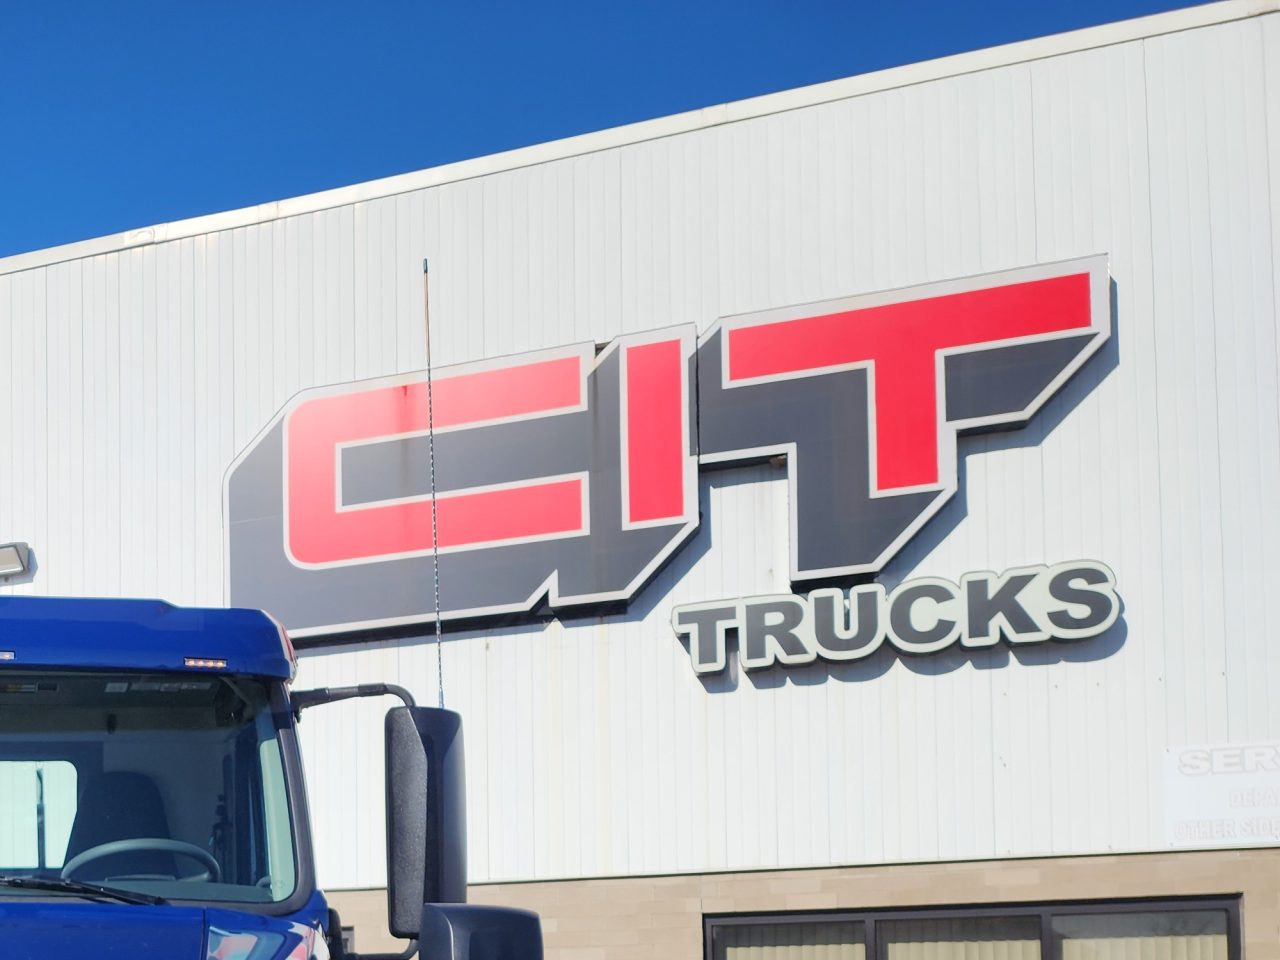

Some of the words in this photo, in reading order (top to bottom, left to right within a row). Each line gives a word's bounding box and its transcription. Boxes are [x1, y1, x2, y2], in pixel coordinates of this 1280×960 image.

[283, 268, 1096, 570] CIT
[677, 566, 1116, 667] TRUCKS
[1177, 744, 1280, 776] SER
